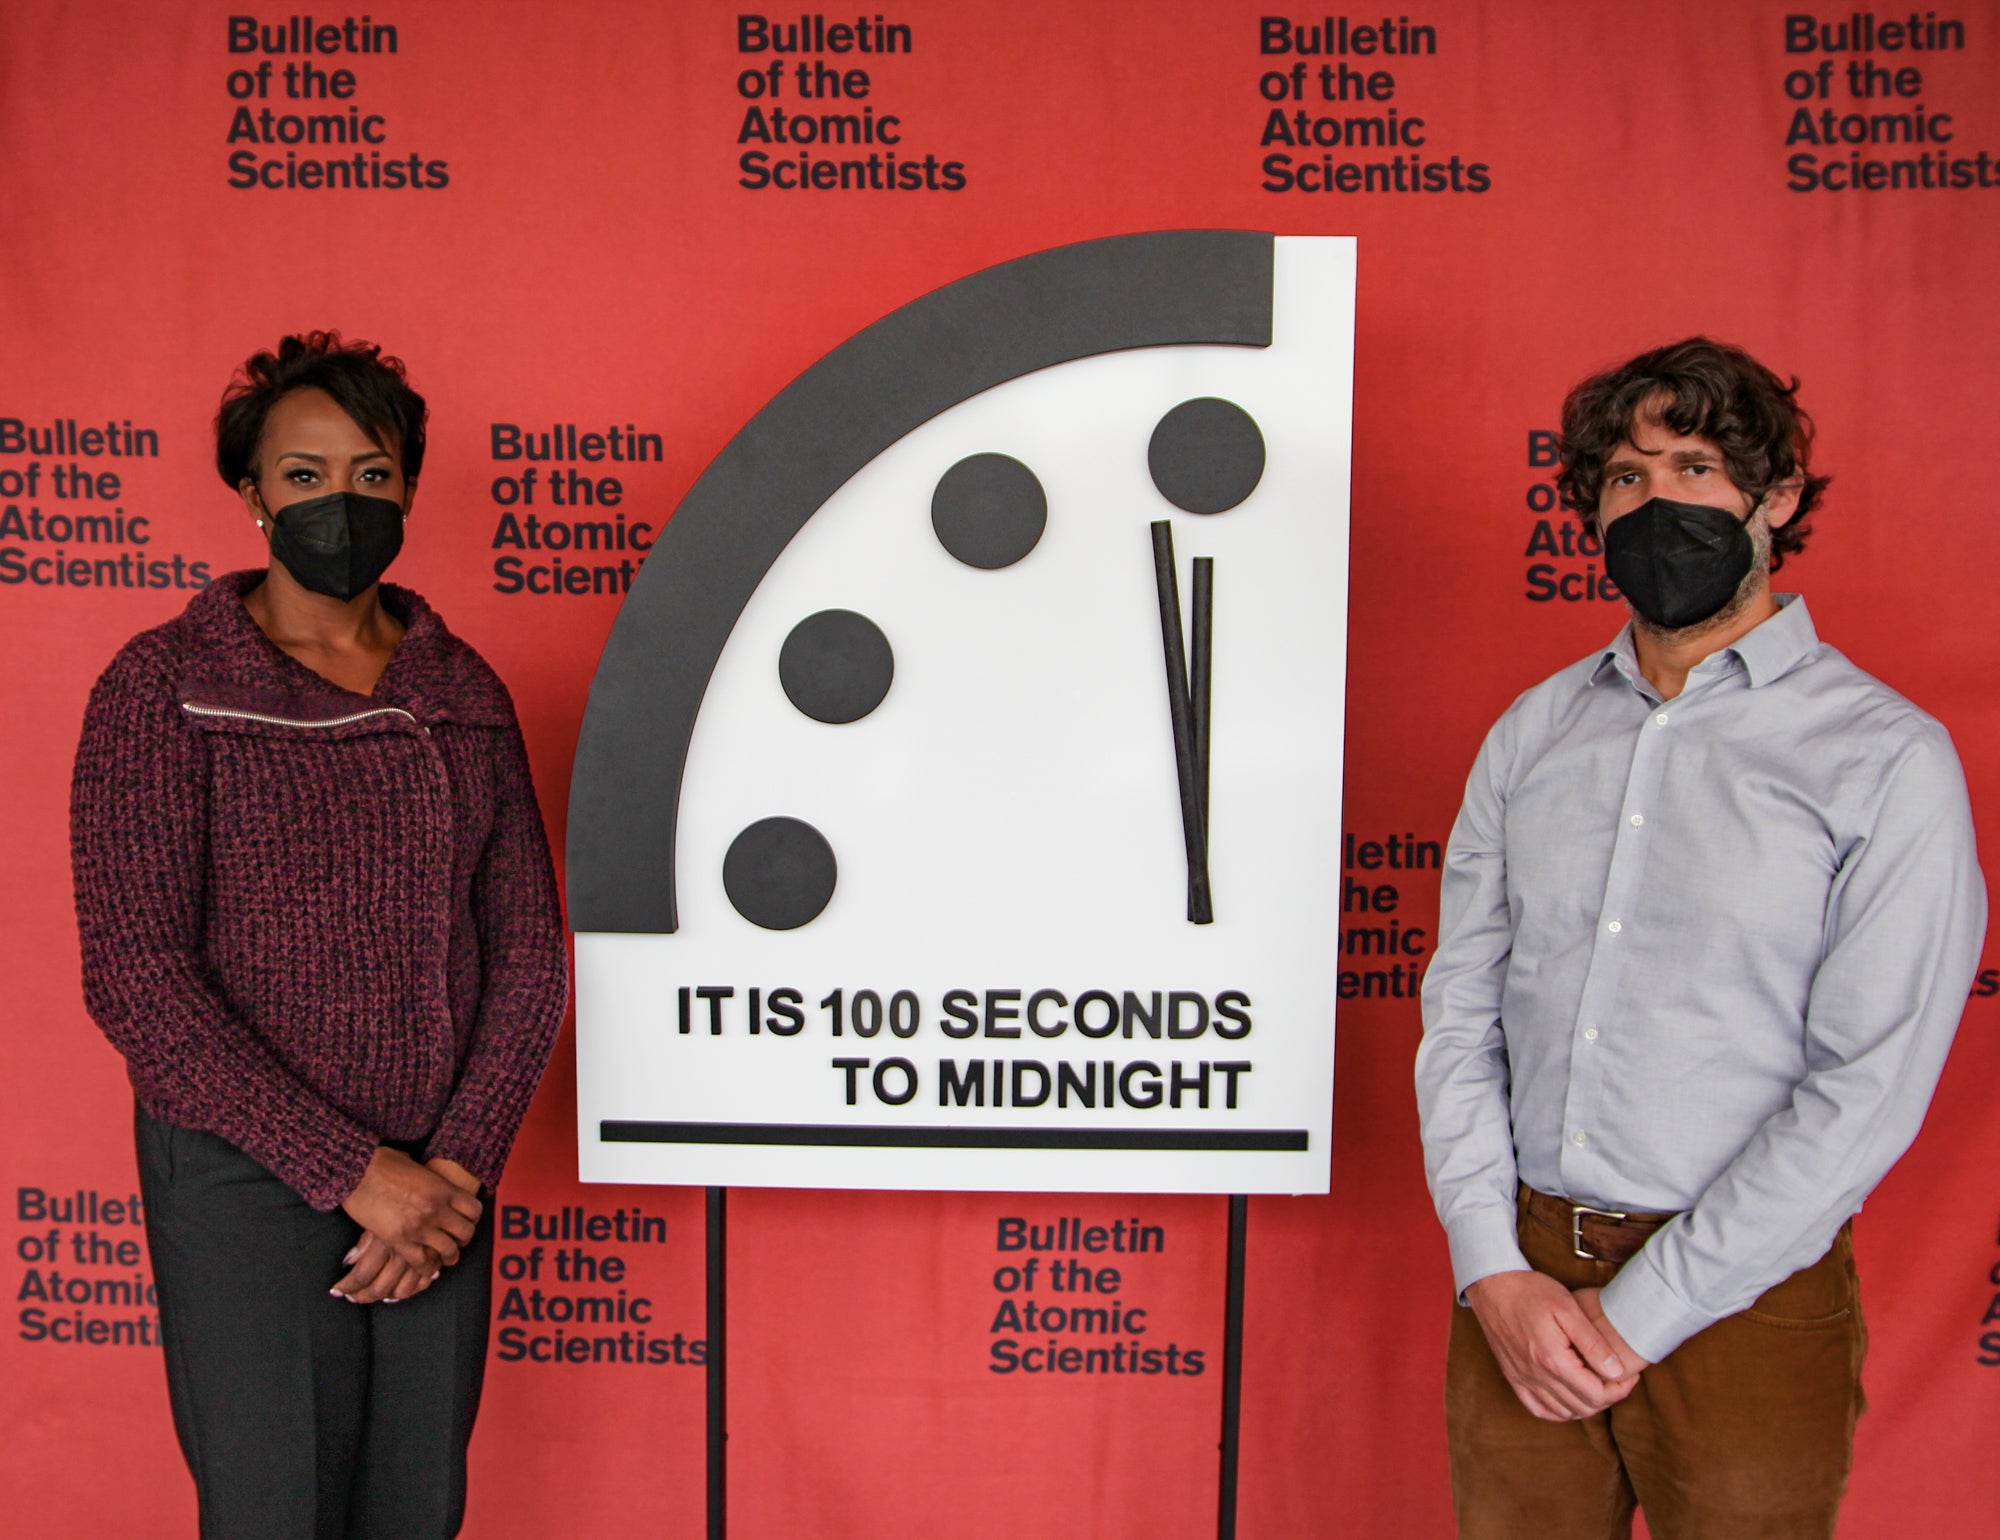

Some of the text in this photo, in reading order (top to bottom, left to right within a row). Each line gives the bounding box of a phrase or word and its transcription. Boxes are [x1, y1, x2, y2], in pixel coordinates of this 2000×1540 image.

[228, 15, 398, 55] Bulletin
[737, 14, 912, 54] Bulletin
[1260, 16, 1437, 56] Bulletin
[1785, 11, 1965, 54] Bulletin
[226, 60, 357, 100] of the
[737, 59, 871, 100] of the
[1259, 61, 1395, 102] of the
[1784, 59, 1923, 101] of the
[226, 105, 386, 145] Atomic
[737, 105, 901, 146] Atomic
[1260, 107, 1426, 148] Atomic
[1785, 104, 1953, 146] Atomic
[227, 150, 450, 190] Scientists
[739, 150, 967, 192] Scientists
[1262, 153, 1491, 194] Scientists
[1787, 149, 2000, 193] Scientist
[0, 417, 159, 457] Bulletin
[490, 423, 663, 463] Bulletin
[0, 461, 122, 501] of the
[491, 467, 623, 507] of the
[0, 504, 150, 545] Atomic
[491, 512, 653, 551] Atomic
[1524, 519, 1604, 557] Ato
[0, 547, 211, 590] Scientists
[492, 555, 644, 595] Scient
[1345, 832, 1441, 871] letin
[1343, 876, 1399, 914] he
[677, 986, 1252, 1040] IT IS 100 SECONDS
[831, 1057, 1252, 1110] TO MIDNIGHT
[17, 1187, 143, 1226] Bullet
[501, 1204, 666, 1243] Bulletin
[17, 1228, 141, 1267] of the
[997, 1217, 1165, 1253] Bulletin
[498, 1246, 626, 1283] of the
[992, 1257, 1122, 1295] of the
[497, 1286, 653, 1324] Atomic
[990, 1299, 1147, 1335] Atomic
[19, 1308, 163, 1348] Scienti
[497, 1328, 707, 1366] Scientists
[989, 1339, 1206, 1377] Scientists
